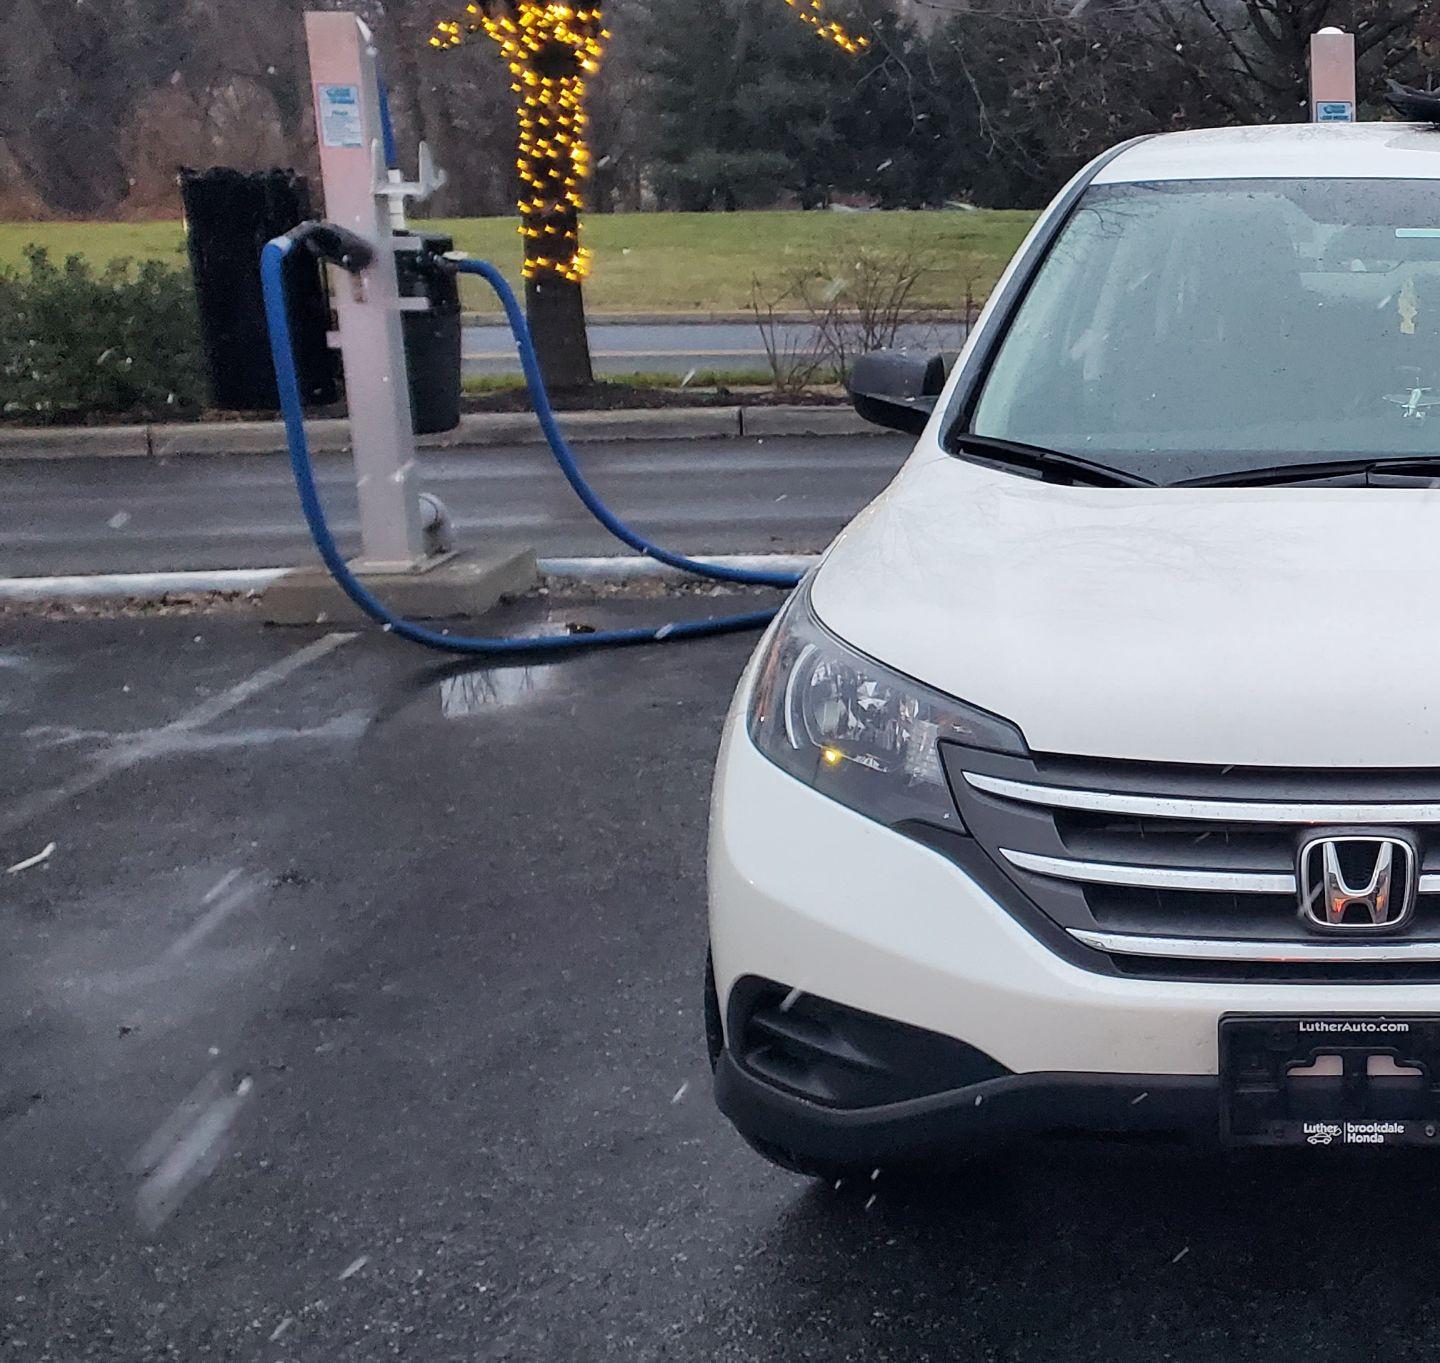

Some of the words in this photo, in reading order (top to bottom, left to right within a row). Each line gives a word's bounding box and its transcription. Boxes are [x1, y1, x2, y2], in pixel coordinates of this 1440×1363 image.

[1299, 1021, 1410, 1033] LutherAuto.com
[1303, 1122, 1339, 1134] Luther
[1347, 1122, 1405, 1134] brookdale
[1347, 1133, 1385, 1144] Honda
